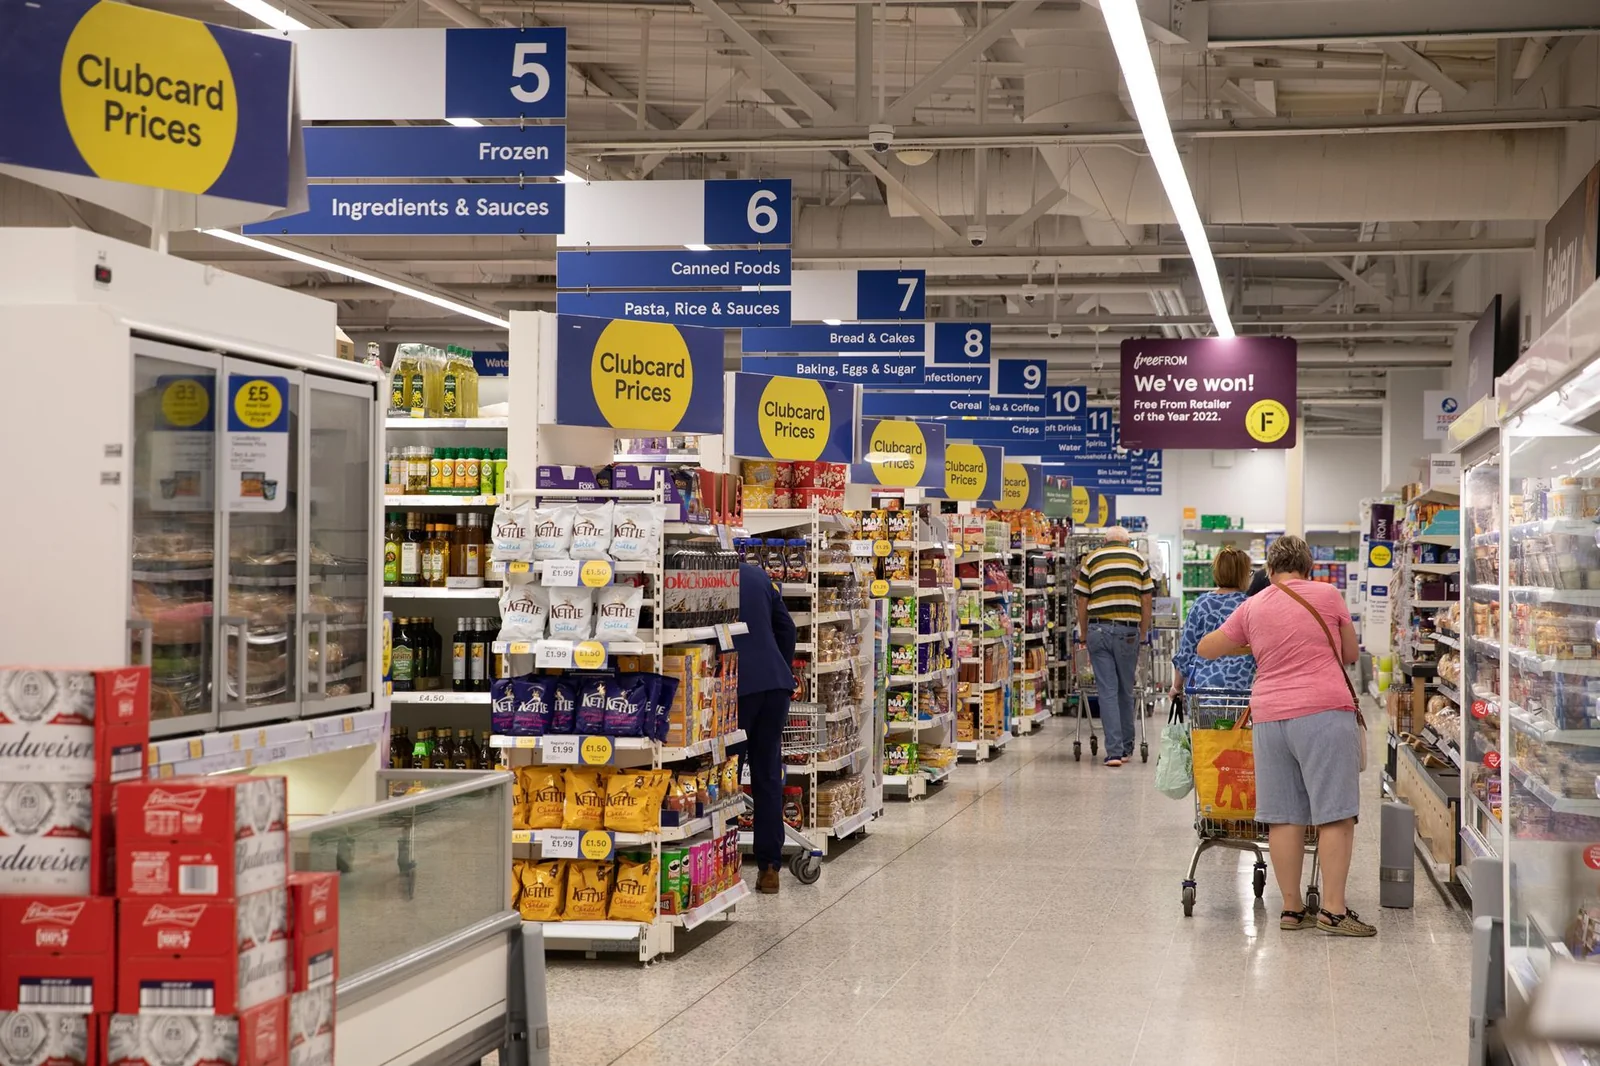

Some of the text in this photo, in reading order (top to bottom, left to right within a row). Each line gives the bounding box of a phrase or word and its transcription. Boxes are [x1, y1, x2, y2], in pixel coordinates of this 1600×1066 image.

[509, 42, 551, 103] 5
[75, 53, 225, 112] Clubcard
[103, 100, 203, 147] Prices
[478, 141, 550, 162] Frozen
[331, 196, 550, 221] Ingredients & Sauces
[746, 189, 778, 234] 6
[671, 261, 781, 276] Canned Foods
[897, 277, 919, 312] 7
[624, 302, 780, 318] Pasta, Rice & Sauces
[829, 332, 916, 344] Bread & Cakes
[963, 329, 984, 358] 8
[599, 351, 686, 379] Clubcard
[796, 363, 917, 377] Baking, Eggs & Sugar
[1023, 364, 1042, 390] 9
[1133, 373, 1255, 392] We've won!
[247, 385, 269, 402] £5
[614, 378, 672, 403] Prices
[949, 400, 983, 410] Cereal
[1002, 403, 1009, 412] &
[1011, 403, 1040, 413] Coffee
[1052, 390, 1081, 413] 10
[1133, 399, 1232, 410] Free From Retailer
[764, 400, 825, 422] Clubcard
[1133, 411, 1222, 422] of the Year 2022.
[1057, 424, 1082, 432] Drinks
[1089, 411, 1108, 431] 11
[1261, 412, 1274, 432] F
[774, 421, 815, 440] Prices
[1011, 425, 1040, 435] Crisps
[874, 439, 923, 455] Clubcard
[1058, 443, 1082, 452] Water
[944, 460, 984, 473] Clubcard
[950, 473, 978, 486] Prices
[496, 521, 526, 538] KETTLE
[534, 520, 563, 538] KETTLE
[614, 521, 646, 539] KETTLE
[552, 569, 574, 577] £1.99
[586, 568, 607, 576] £1.50
[507, 598, 543, 615] KETTLE
[551, 603, 584, 620] KETTLE
[600, 602, 635, 618] KETTLE
[545, 650, 567, 658] £1.99
[418, 694, 445, 702] £4.50
[605, 696, 639, 714] KETTLE
[552, 746, 574, 754] £1.99
[585, 744, 607, 752] £1.50
[551, 840, 574, 848] £1.99
[585, 839, 607, 847] £1.50
[523, 881, 555, 899] KETTLE
[572, 886, 606, 902] KETTLE
